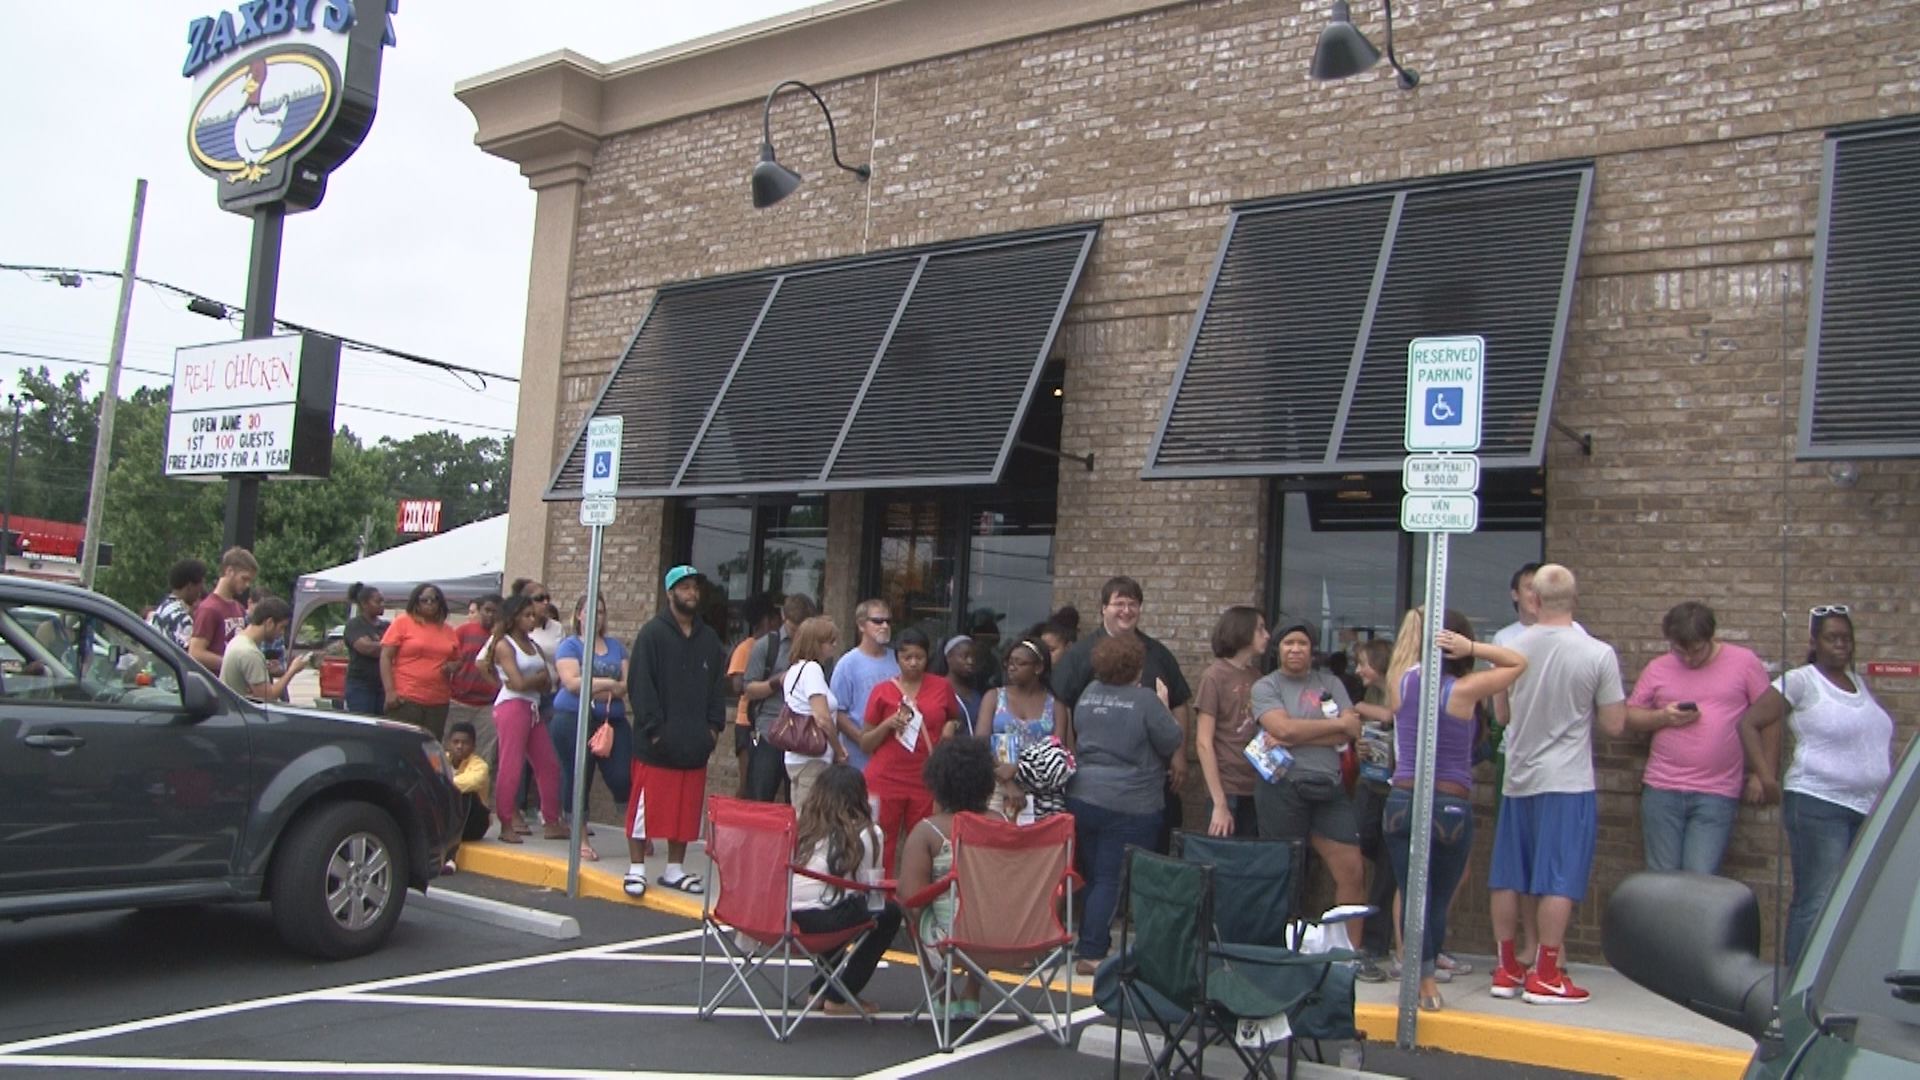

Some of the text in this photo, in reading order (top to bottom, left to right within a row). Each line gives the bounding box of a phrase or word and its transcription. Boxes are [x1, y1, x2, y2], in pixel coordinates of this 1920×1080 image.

[183, 0, 354, 77] ZAXBYS
[1414, 347, 1478, 364] RESERVED
[184, 352, 294, 394] REAL CHICKEN
[1417, 367, 1473, 382] PARKING
[192, 413, 261, 432] OPEN JUNE 30
[187, 431, 275, 451] 1ST 100 GUESTS
[168, 454, 188, 470] FREE
[231, 451, 248, 468] FOR
[251, 450, 260, 466] A
[265, 449, 290, 466] YEAR
[1411, 461, 1471, 472] MAXIMUM PENALTY
[1423, 474, 1459, 485] $100.00
[1431, 500, 1450, 511] VAN
[1409, 512, 1470, 526] ACCESSIBLE
